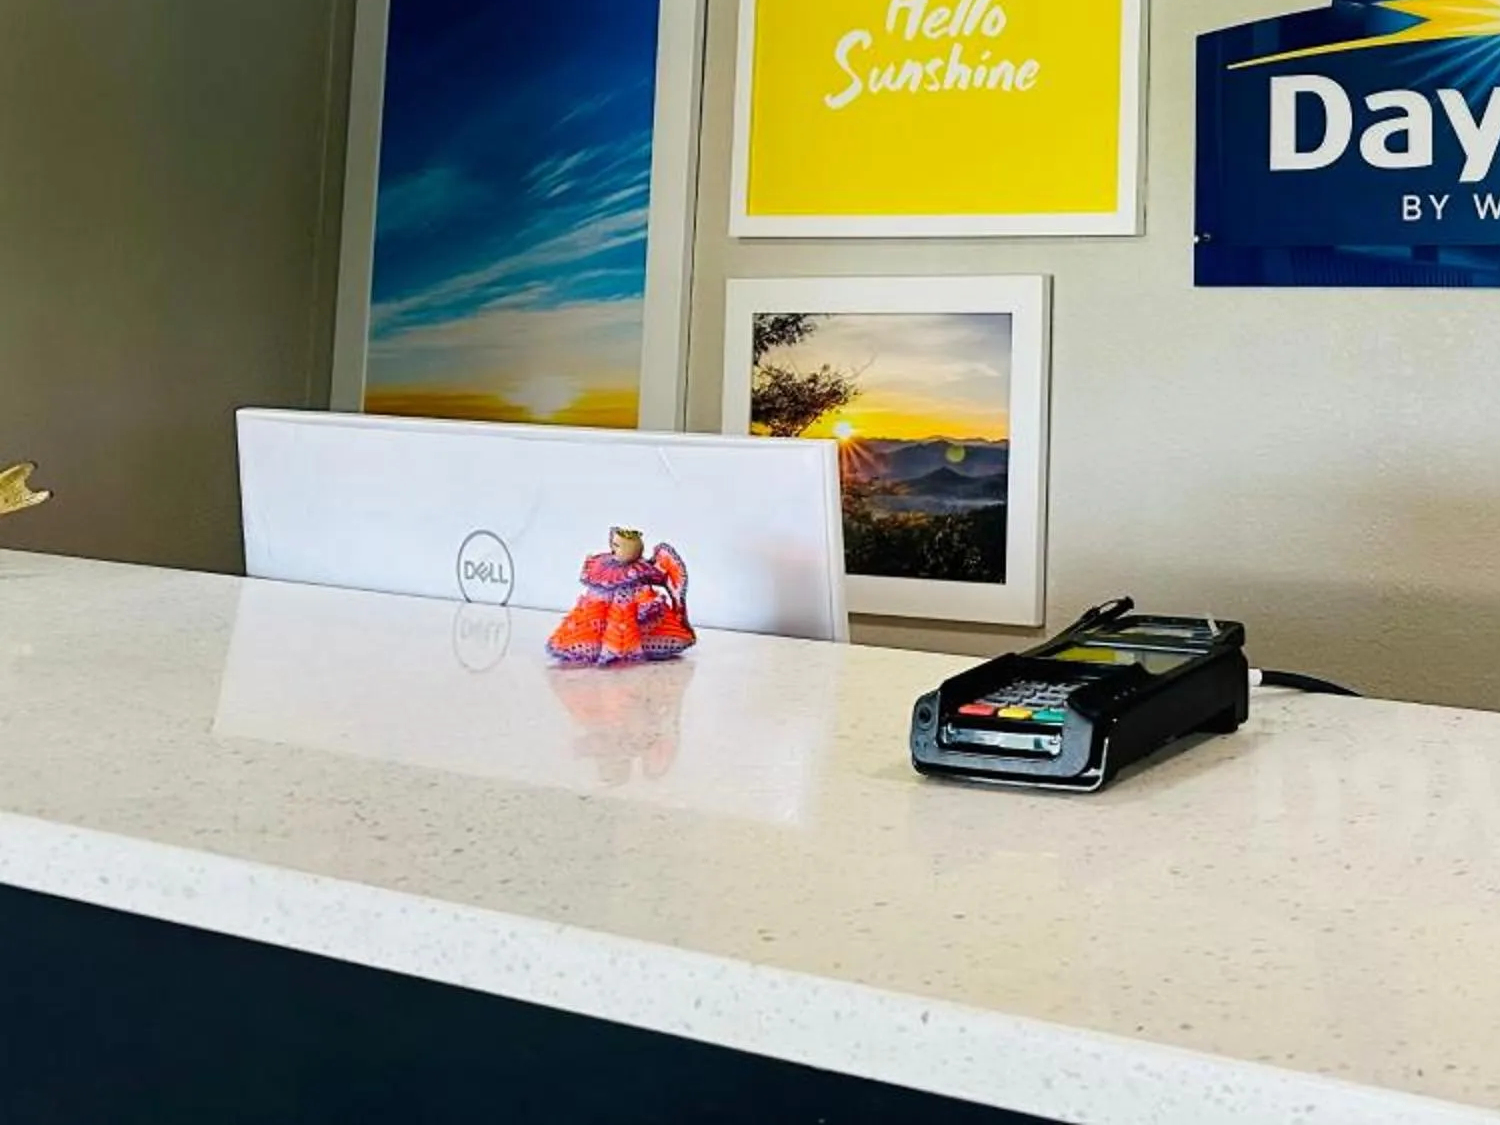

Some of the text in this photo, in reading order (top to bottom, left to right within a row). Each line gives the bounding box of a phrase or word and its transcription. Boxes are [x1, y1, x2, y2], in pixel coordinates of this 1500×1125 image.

[824, 29, 1040, 110] Sunshine
[1402, 194, 1450, 221] BY
[464, 561, 508, 584] DELL
